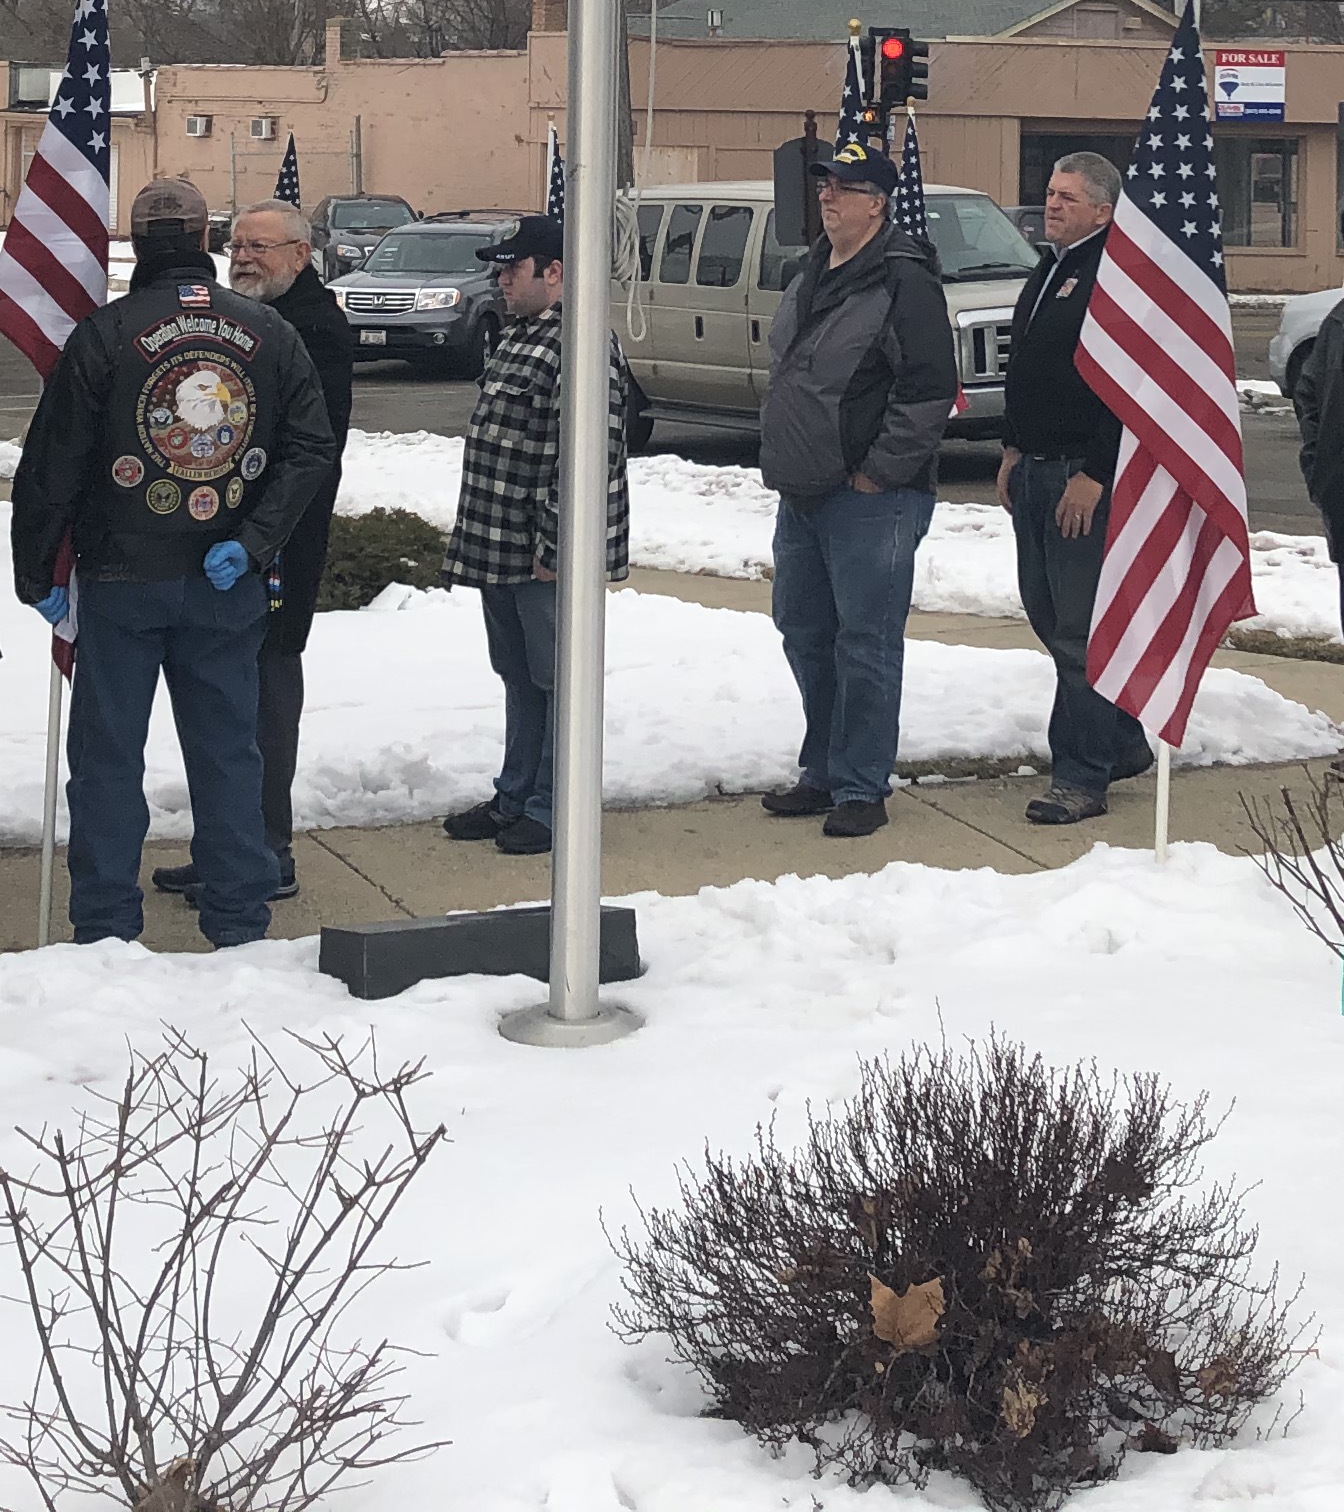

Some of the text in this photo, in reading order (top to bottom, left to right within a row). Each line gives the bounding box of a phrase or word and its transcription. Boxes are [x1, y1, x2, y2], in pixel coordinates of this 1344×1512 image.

[1221, 53, 1280, 64] FOR SALE
[140, 314, 254, 353] Operation Welcome You Home
[142, 360, 171, 394] FORGETS
[170, 354, 183, 366] ITS
[184, 350, 231, 366] DEFENDERS
[230, 360, 246, 378] WILL
